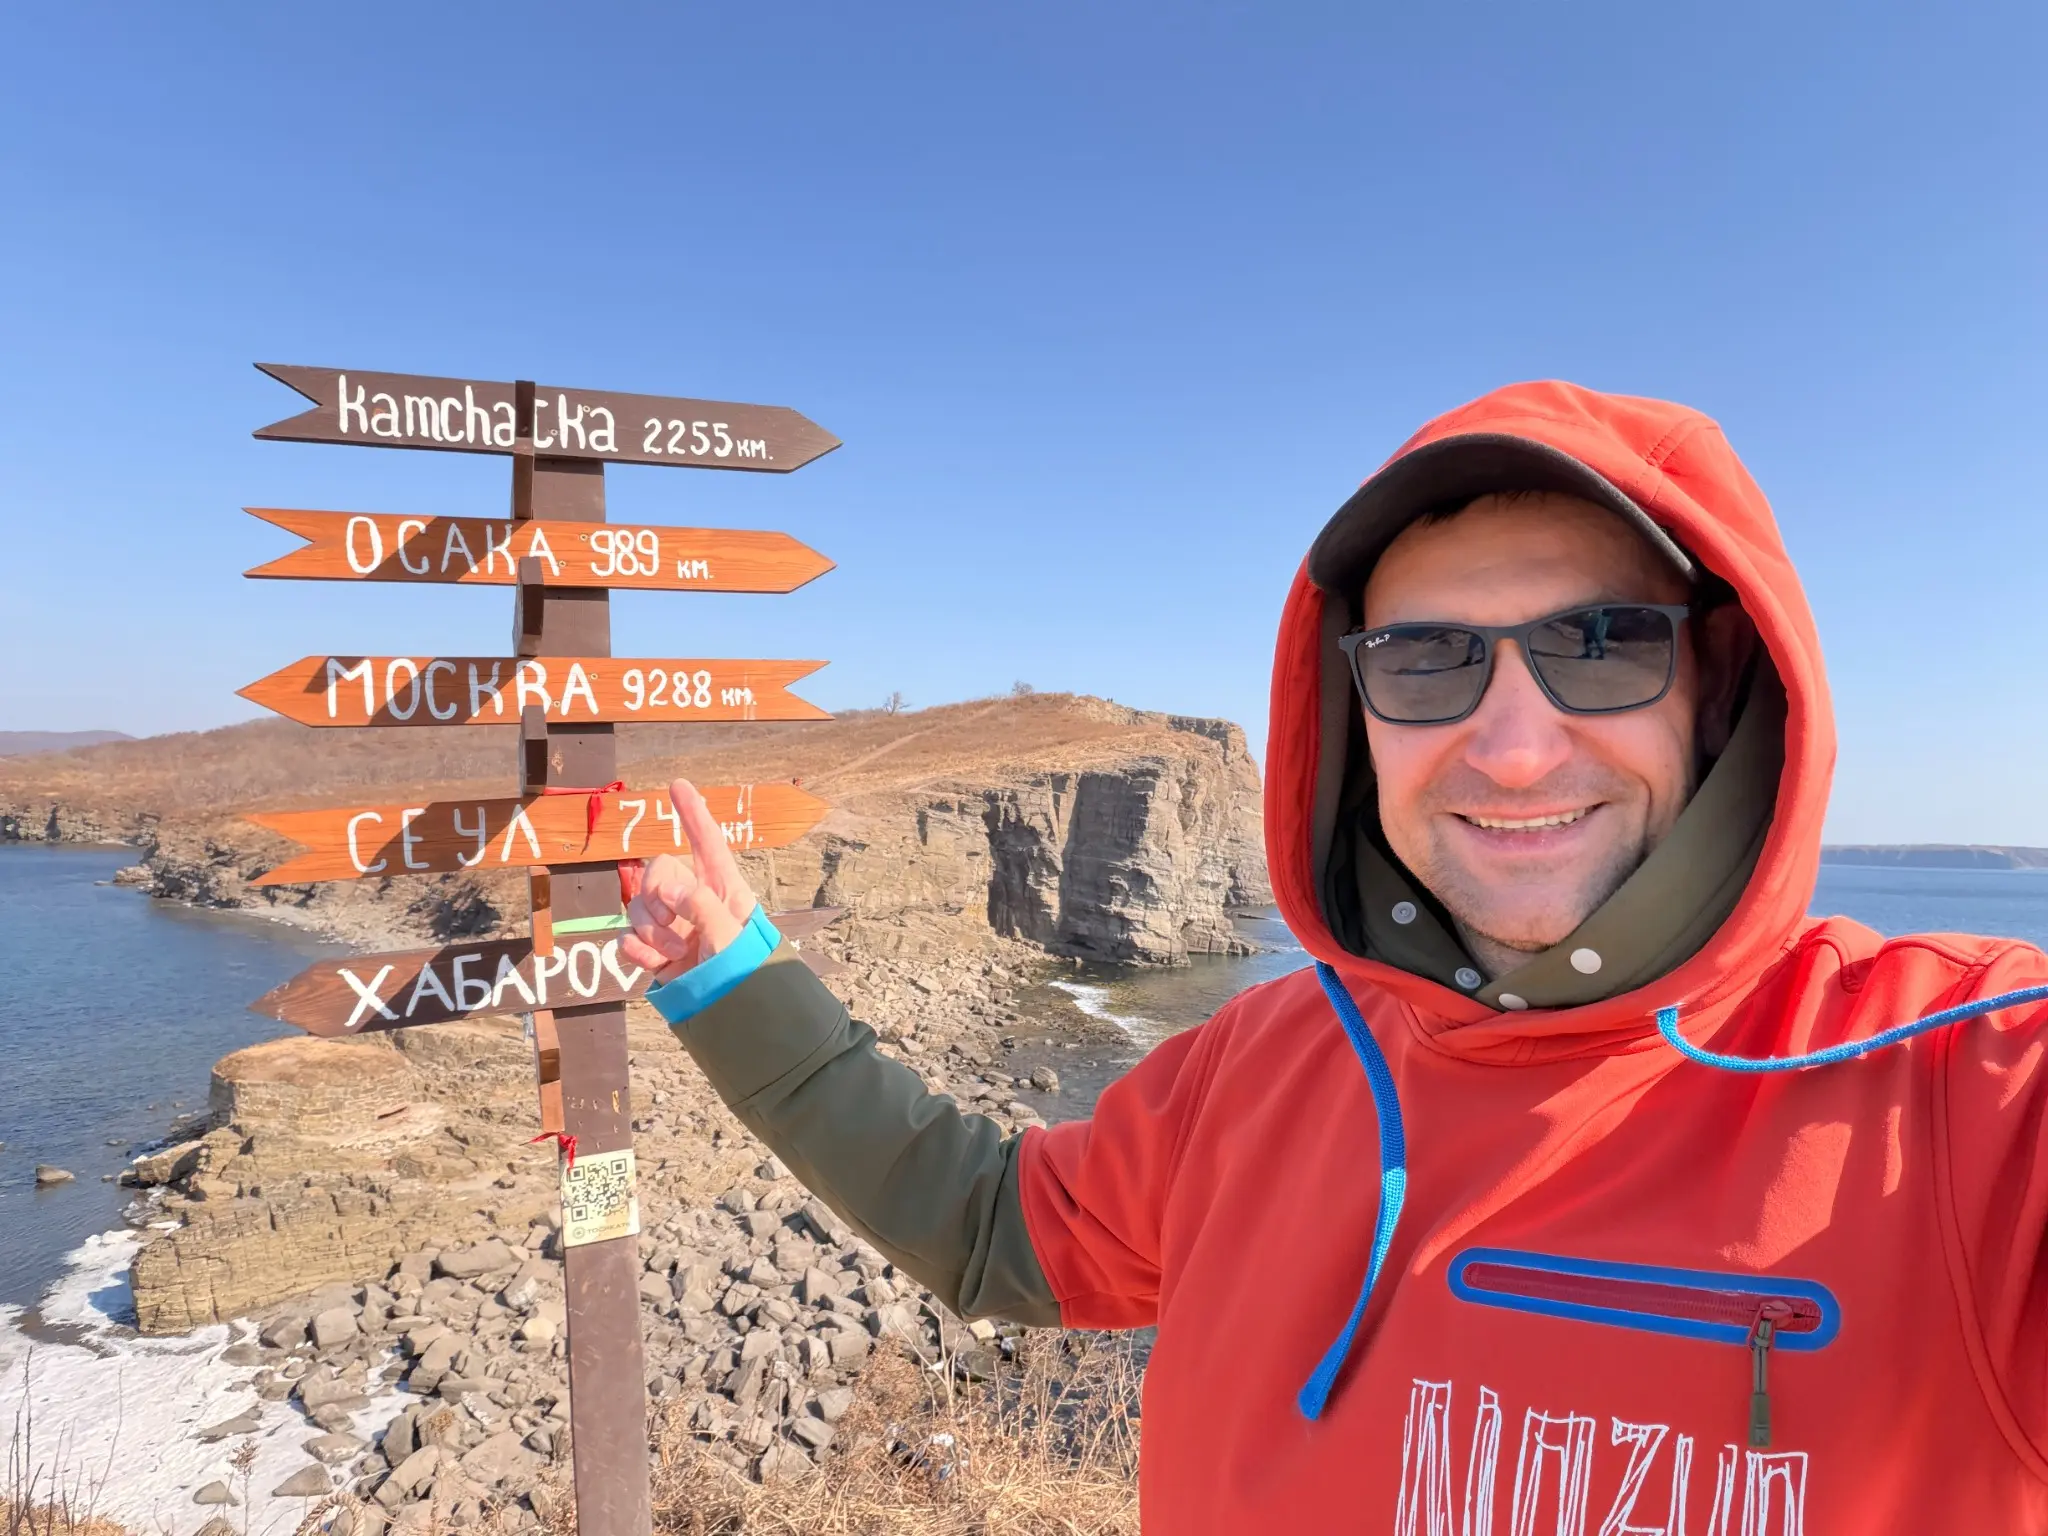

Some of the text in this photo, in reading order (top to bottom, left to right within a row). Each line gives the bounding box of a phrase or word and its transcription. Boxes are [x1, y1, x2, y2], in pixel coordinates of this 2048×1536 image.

[643, 417, 734, 457] 2255
[345, 516, 560, 577] ОСАКА
[590, 529, 659, 577] 989
[326, 658, 600, 720] МОСКВА
[622, 668, 712, 711] 9288
[347, 803, 542, 873] СЕУЛ
[619, 798, 706, 853] 74
